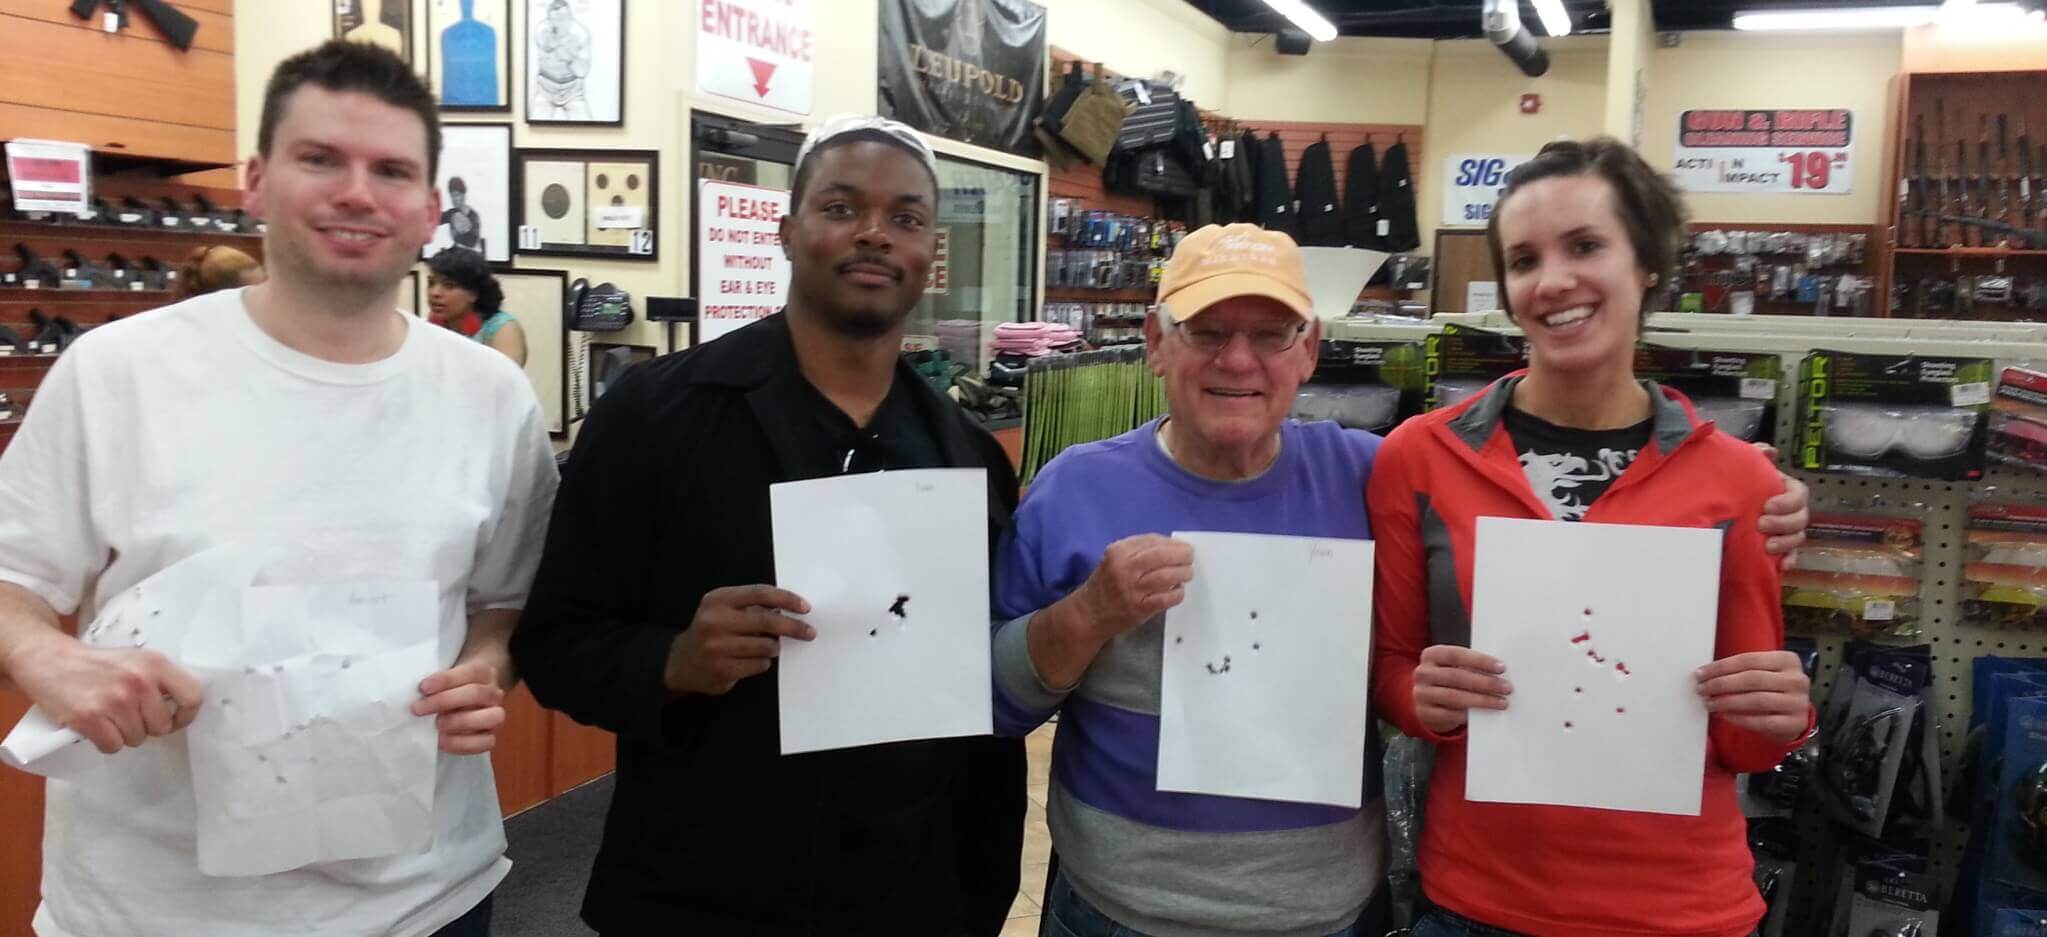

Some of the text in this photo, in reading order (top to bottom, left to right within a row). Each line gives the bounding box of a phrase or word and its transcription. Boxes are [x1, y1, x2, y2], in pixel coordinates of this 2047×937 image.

[702, 0, 811, 62] ENTRANCE
[911, 44, 1024, 103] LEUPOLD
[718, 195, 781, 222] PLEASE
[633, 231, 651, 252] 12
[709, 227, 782, 246] DO NOT ENTE
[724, 255, 773, 270] WITHOUT
[720, 280, 776, 295] EAR & EYE
[1805, 356, 1829, 469] PELTOR
[1881, 884, 1928, 903] BERETTA
